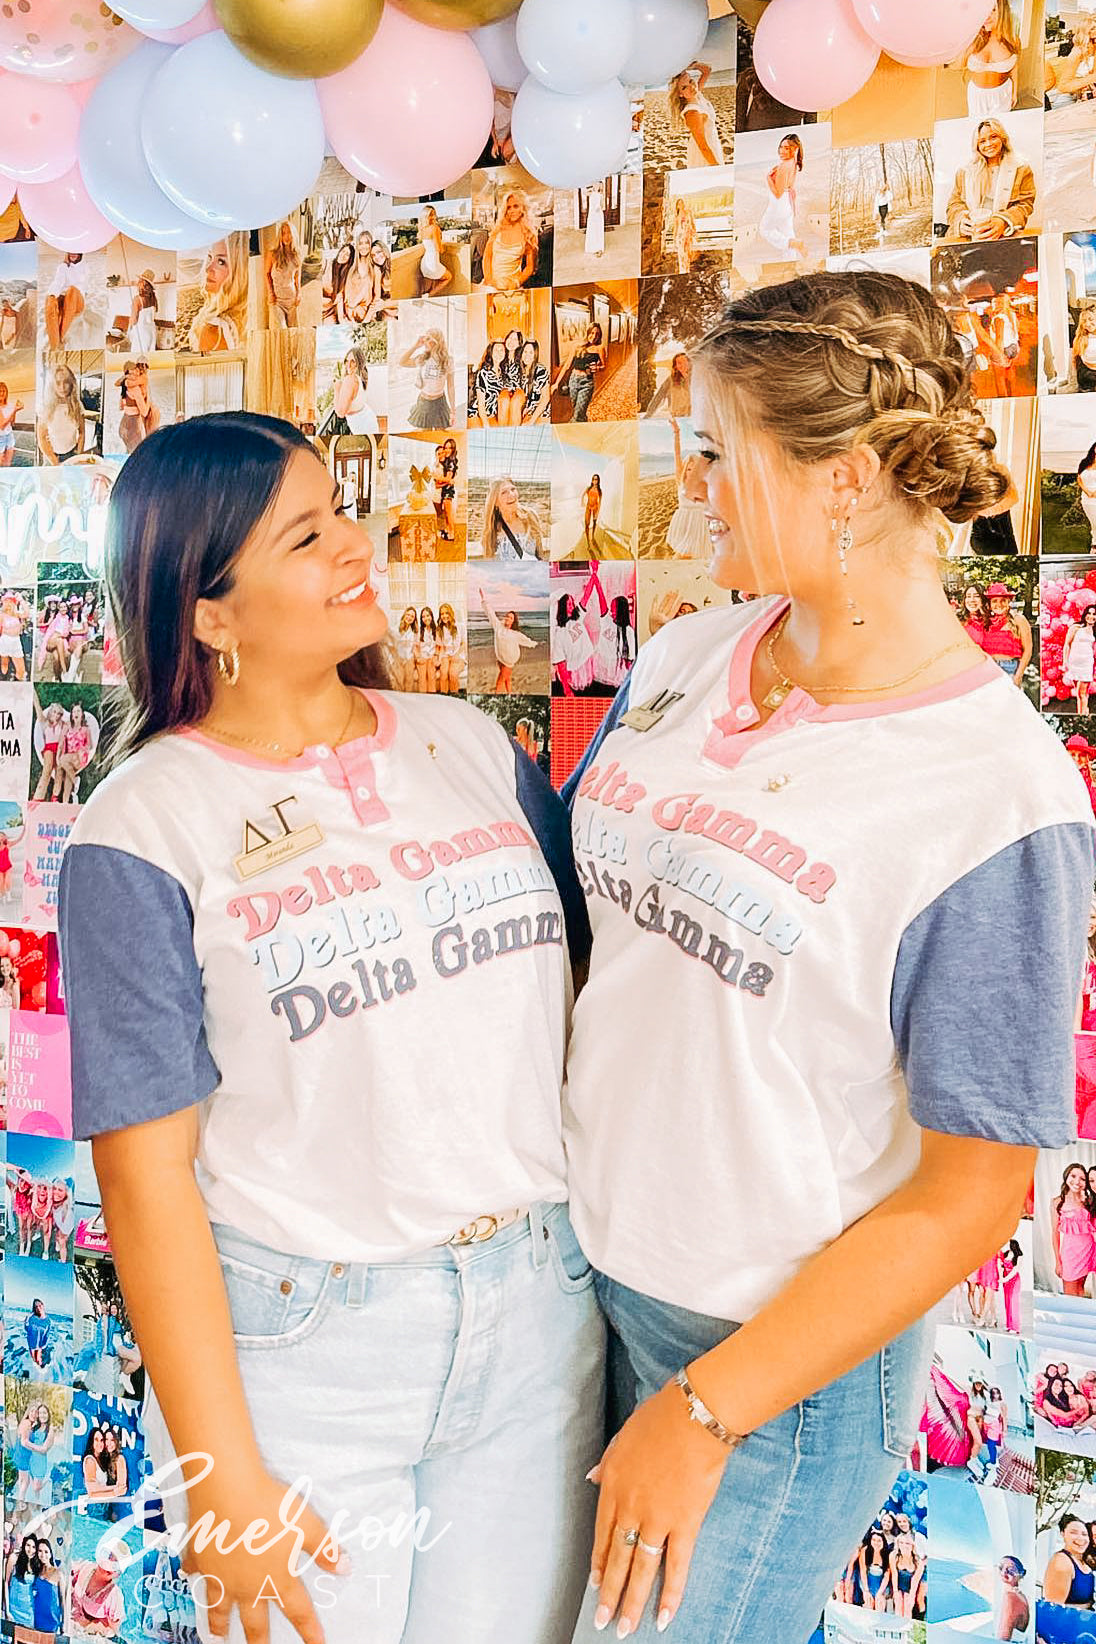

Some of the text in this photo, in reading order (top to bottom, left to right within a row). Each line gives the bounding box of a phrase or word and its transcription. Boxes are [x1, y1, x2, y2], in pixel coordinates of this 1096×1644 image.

[578, 761, 837, 903] elta Gamma
[226, 821, 538, 942] Delta Gamm
[573, 810, 803, 956] elta Gamma
[575, 860, 632, 914] elta
[250, 866, 556, 994] Delta Gamm
[270, 911, 563, 1043] Delta Gamm
[11, 1045, 41, 1059] BEST
[12, 1032, 39, 1045] THE
[11, 1058, 22, 1070] IS
[11, 1070, 36, 1085] YET
[9, 1096, 47, 1112] COME
[11, 1084, 28, 1097] TO
